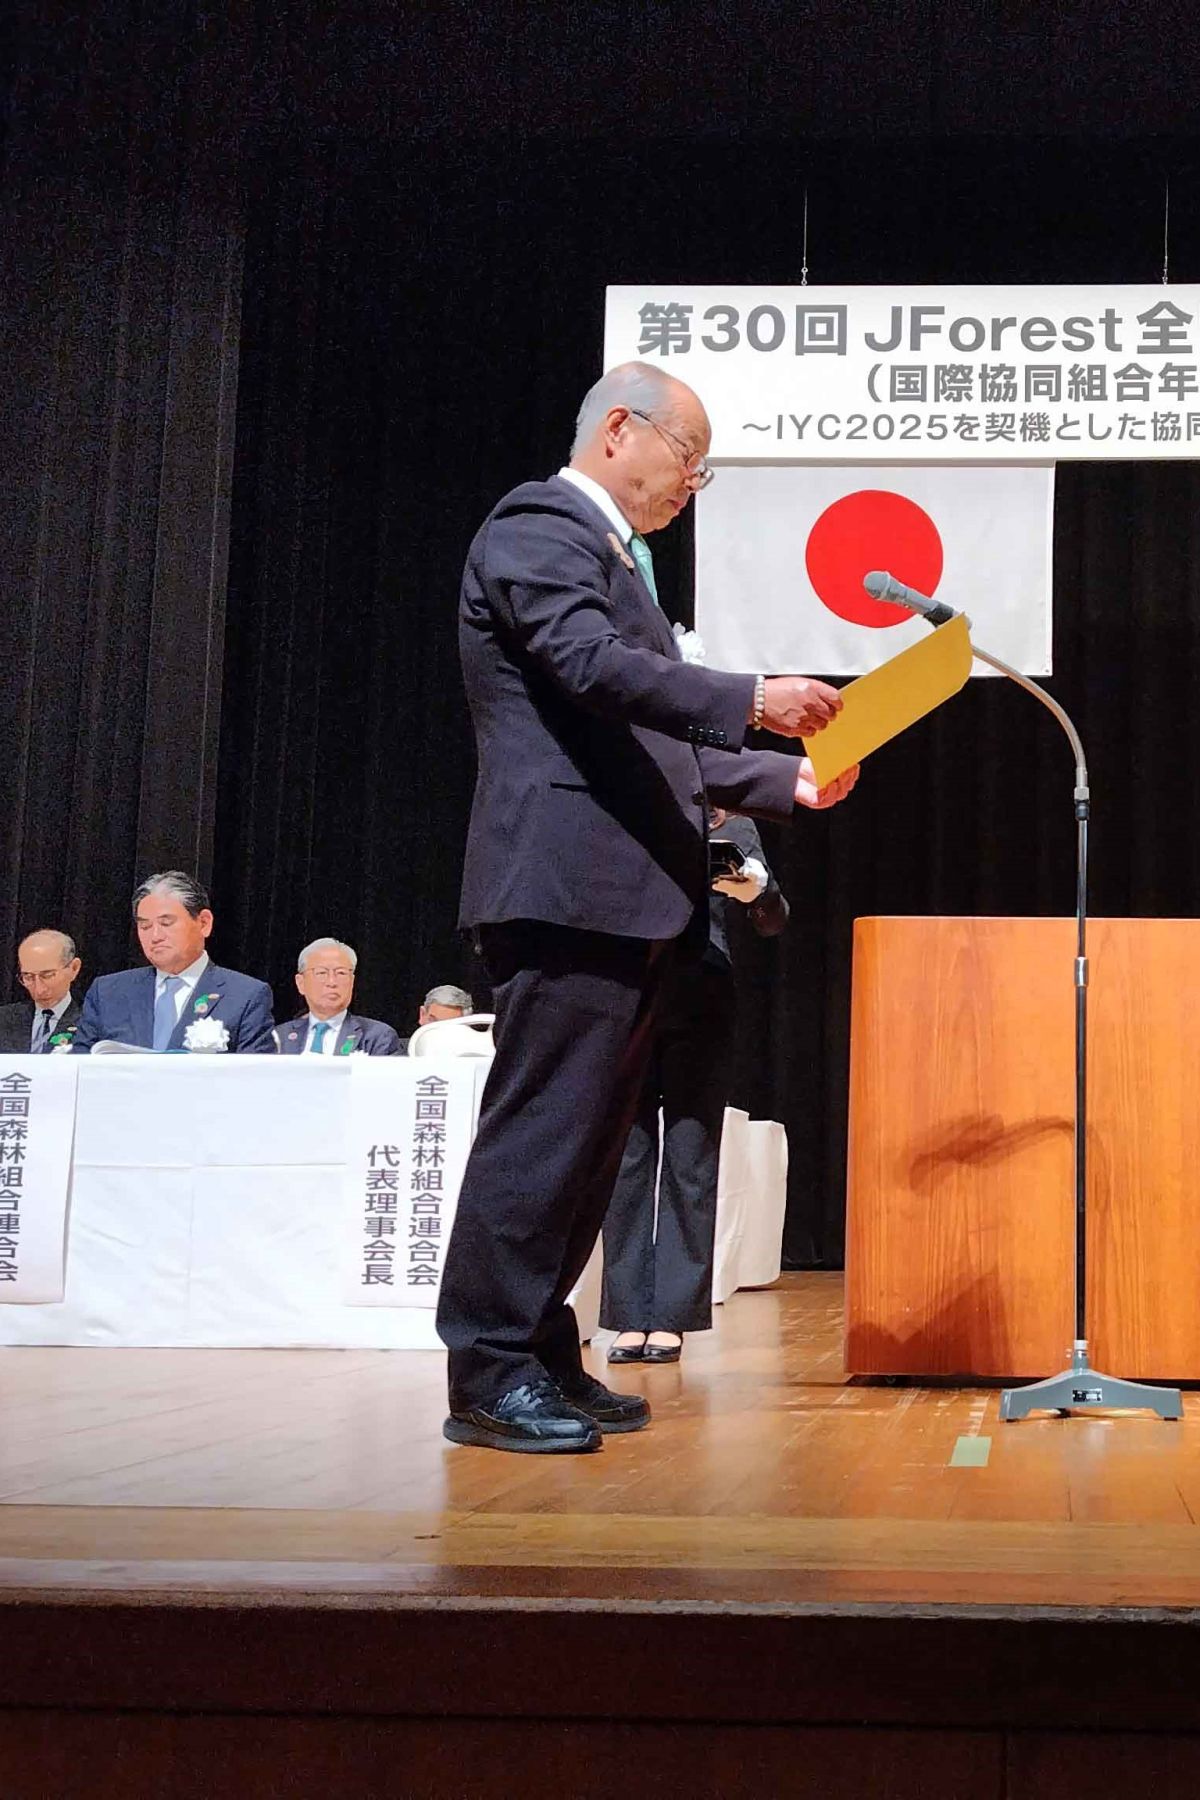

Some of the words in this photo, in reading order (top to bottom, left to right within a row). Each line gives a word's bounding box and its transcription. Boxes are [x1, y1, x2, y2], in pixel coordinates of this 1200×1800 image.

[361, 1144, 401, 1286] 代表理事会長
[406, 1075, 449, 1286] 全国森林組合連合会
